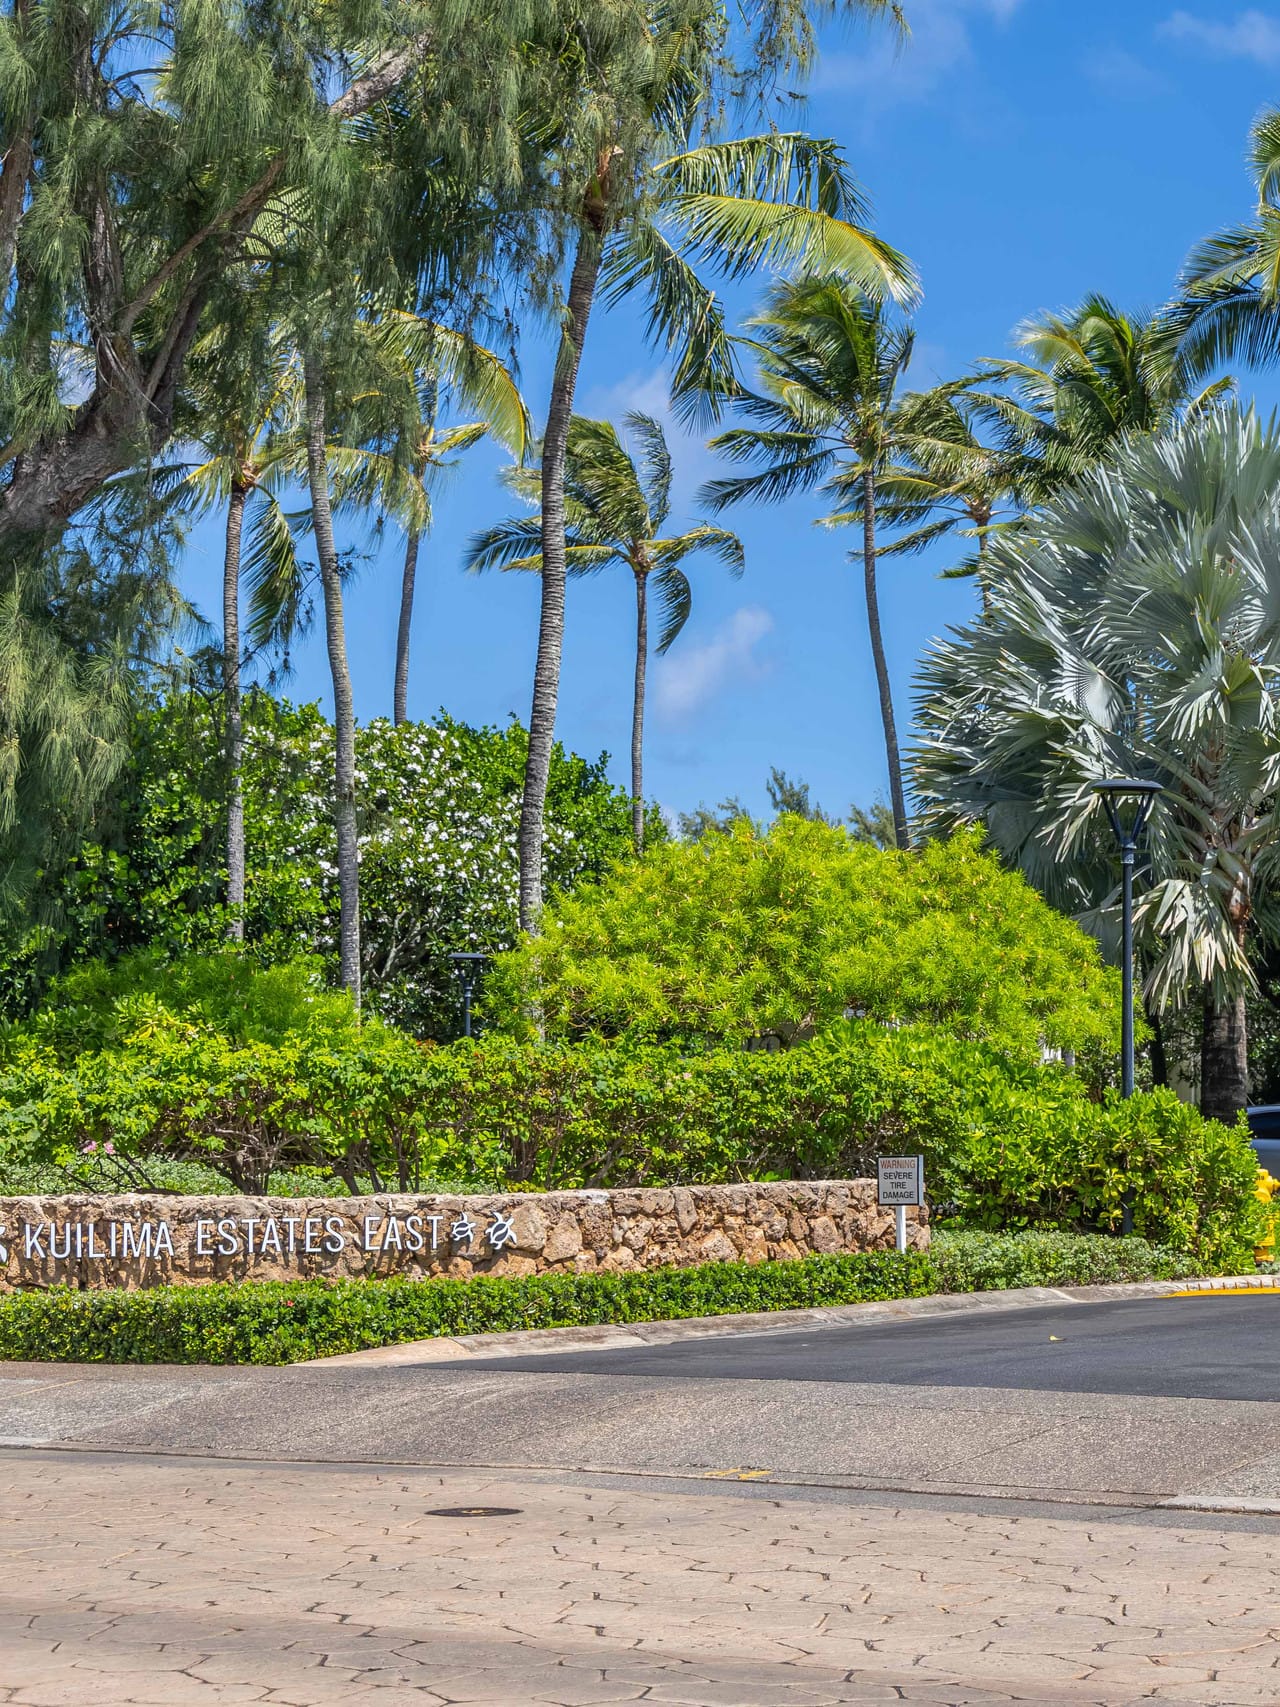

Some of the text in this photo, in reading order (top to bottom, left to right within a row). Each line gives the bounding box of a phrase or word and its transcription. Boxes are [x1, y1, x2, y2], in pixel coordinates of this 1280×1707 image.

[880, 1160, 916, 1169] WARNING
[883, 1171, 913, 1180] SEVERE
[890, 1181, 907, 1190] TIRE
[882, 1191, 915, 1199] DAMAGE
[24, 1215, 444, 1260] KUILIMA ESTATES EAST
